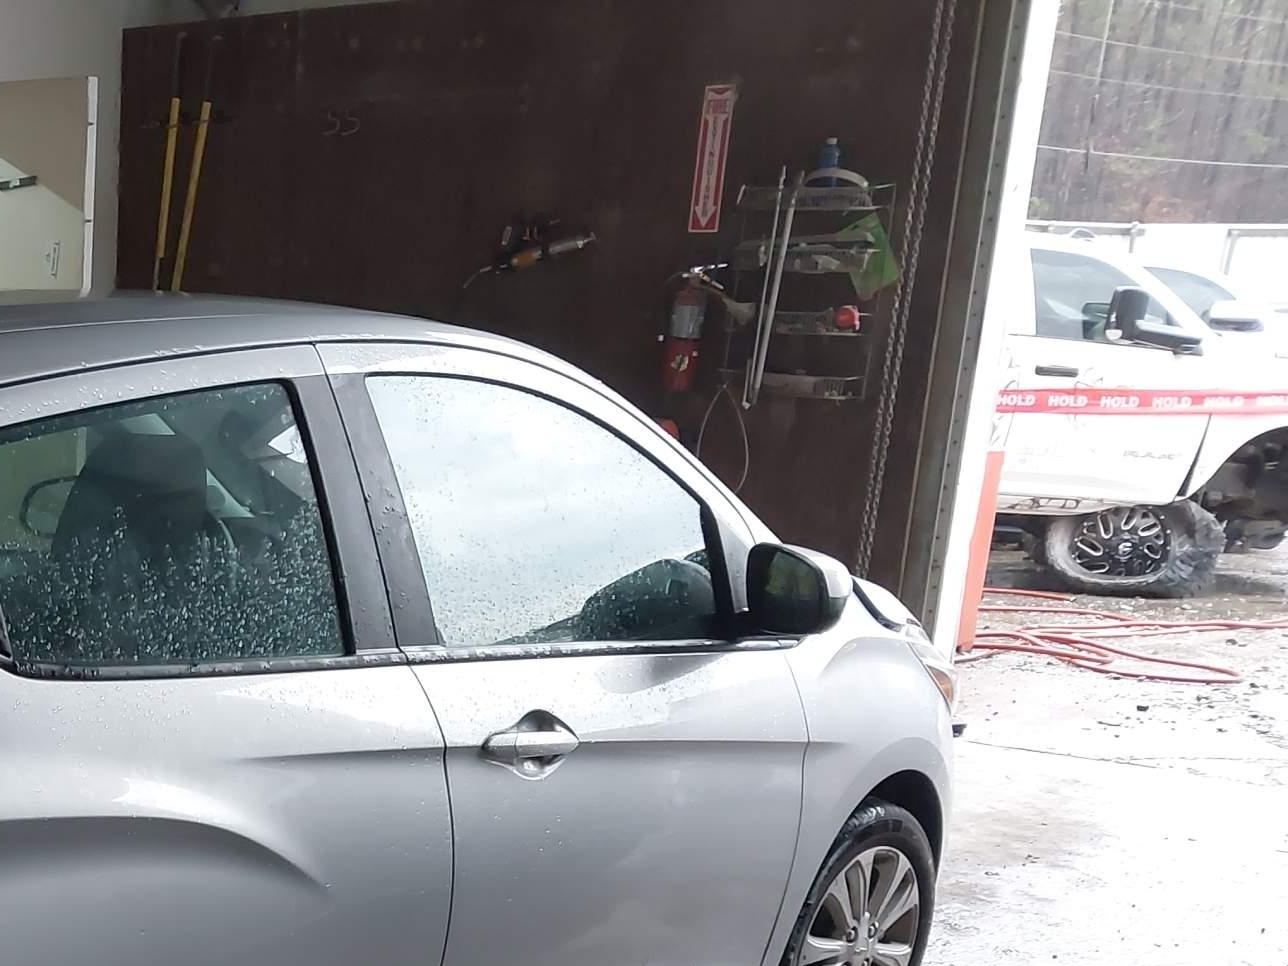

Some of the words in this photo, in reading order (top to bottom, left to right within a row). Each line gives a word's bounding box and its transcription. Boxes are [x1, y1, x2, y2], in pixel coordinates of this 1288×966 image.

[999, 394, 1036, 406] HOLD
[1048, 395, 1088, 408] HOLD
[1100, 396, 1140, 408] HOLD
[1152, 397, 1192, 409] HOLD
